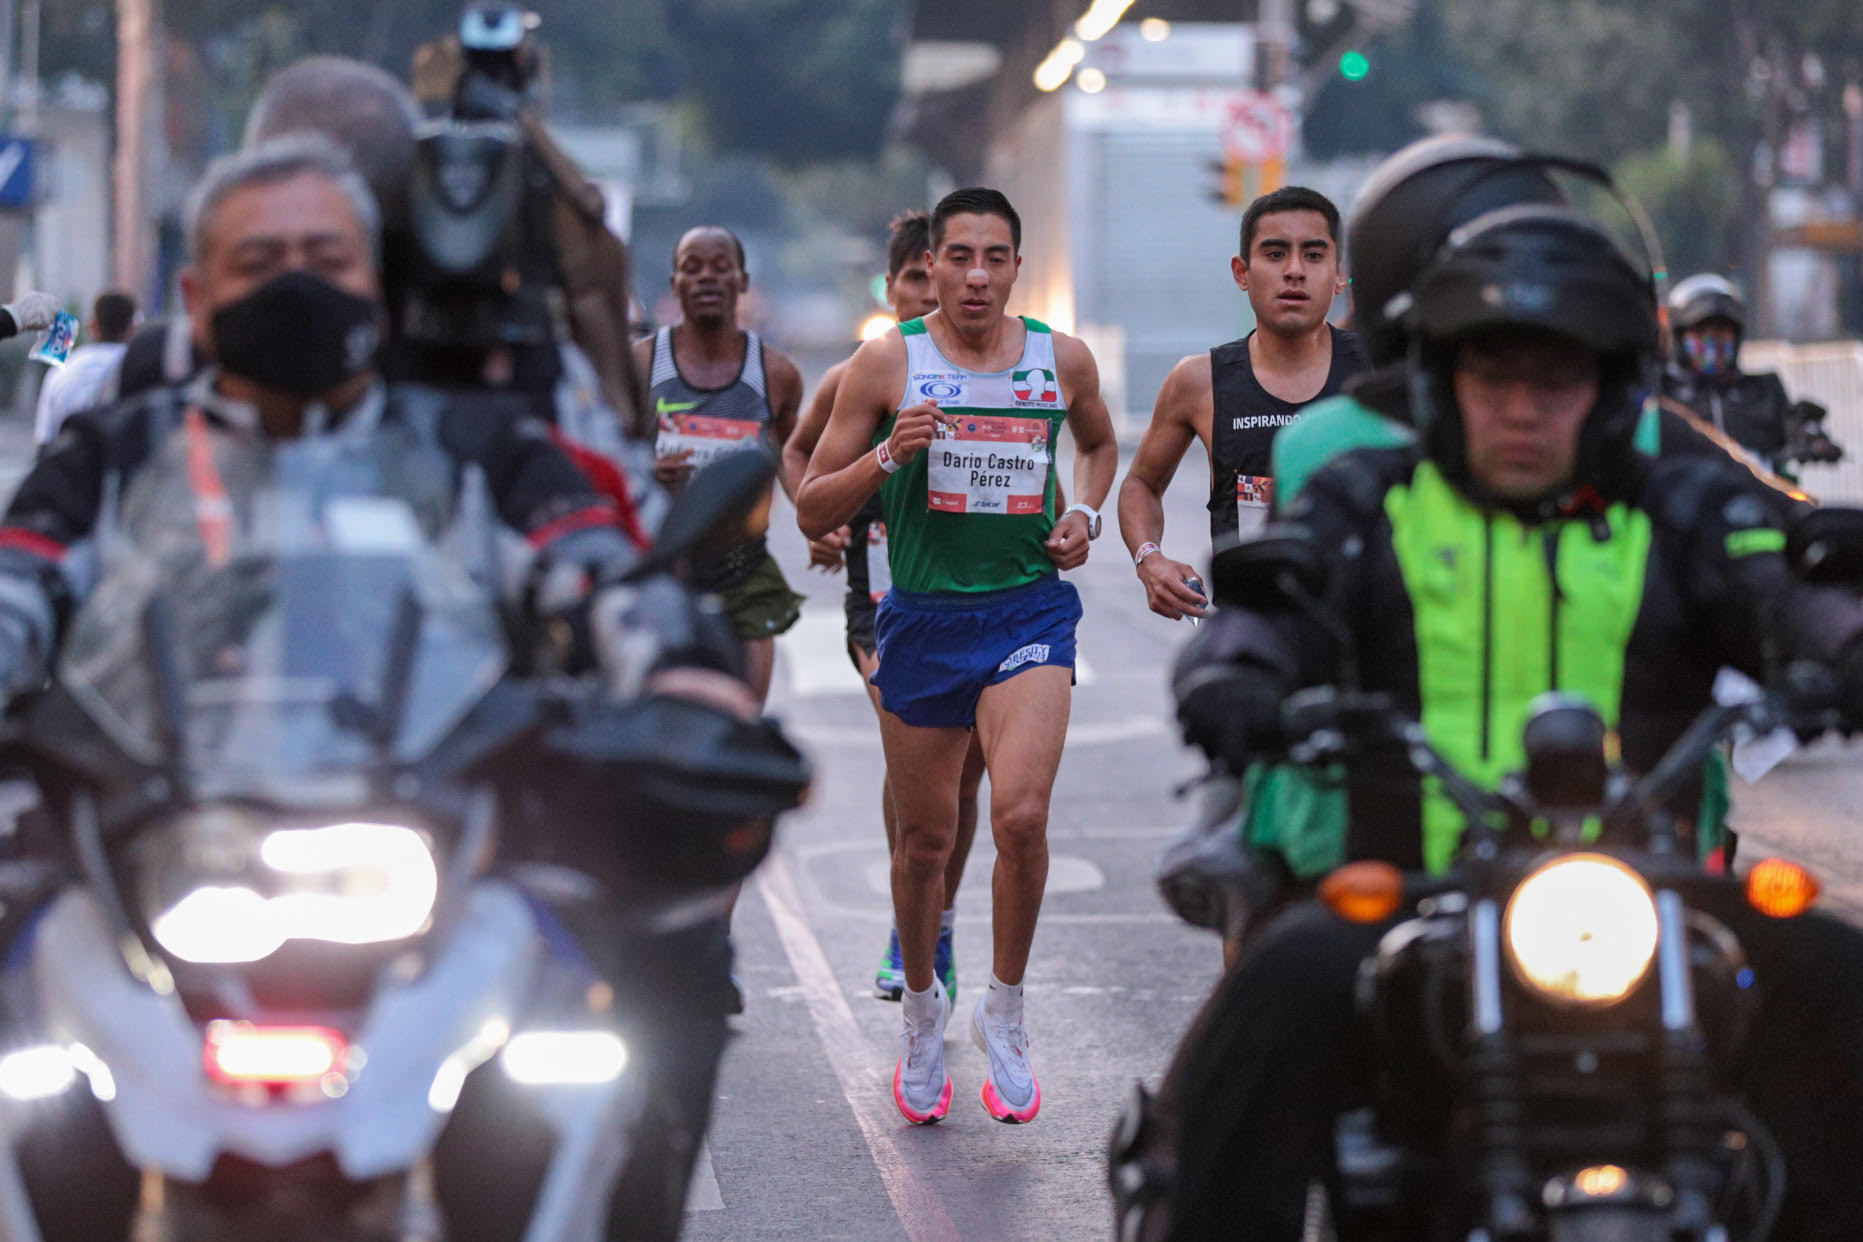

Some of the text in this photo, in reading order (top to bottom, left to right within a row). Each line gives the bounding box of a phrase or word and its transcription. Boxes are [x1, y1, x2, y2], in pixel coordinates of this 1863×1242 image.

[943, 451, 1034, 471] Dario Castro
[970, 470, 1011, 488] Pérez
